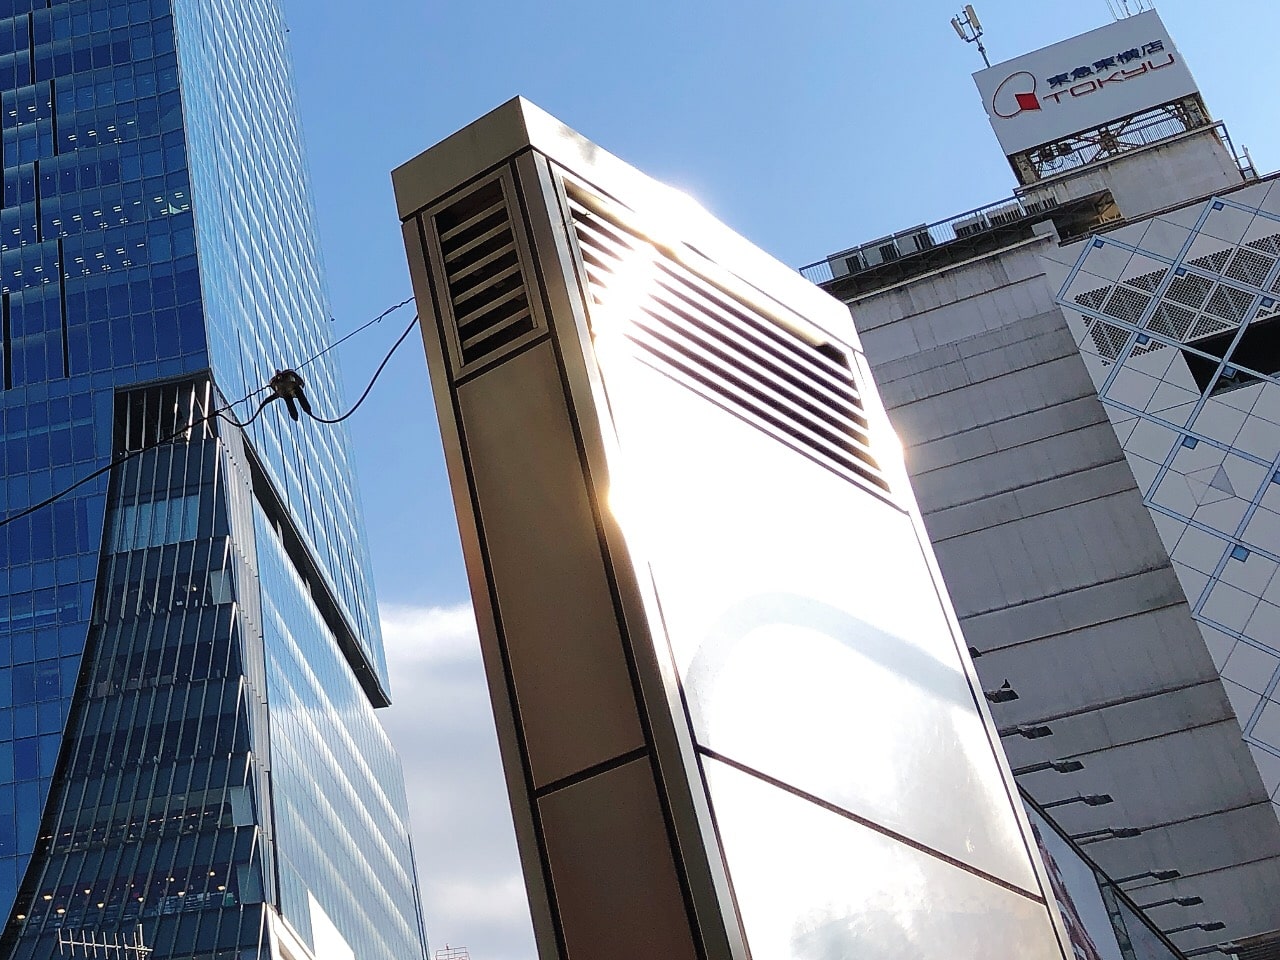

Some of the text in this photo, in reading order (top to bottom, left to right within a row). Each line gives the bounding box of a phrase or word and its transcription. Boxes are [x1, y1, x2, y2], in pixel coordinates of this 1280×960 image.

[1042, 53, 1175, 104] TOKYU
[1046, 39, 1165, 89] 東急東横店
